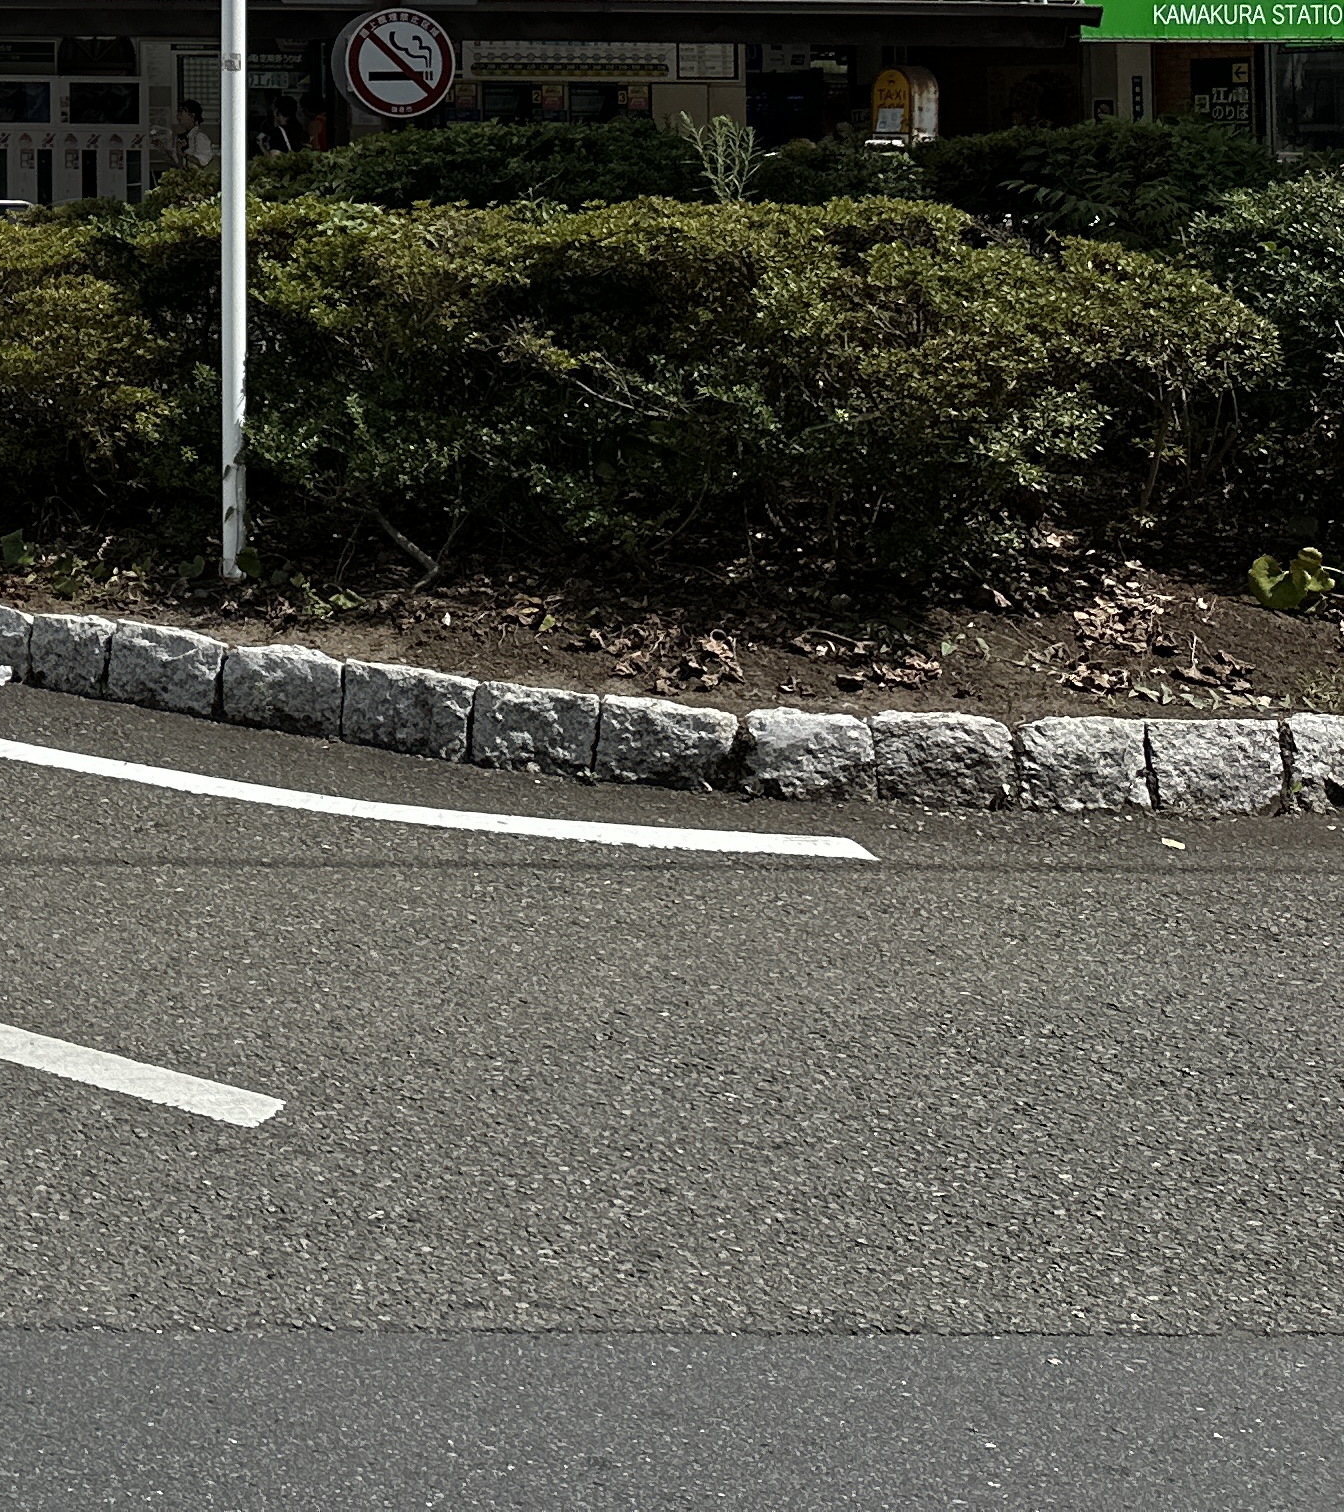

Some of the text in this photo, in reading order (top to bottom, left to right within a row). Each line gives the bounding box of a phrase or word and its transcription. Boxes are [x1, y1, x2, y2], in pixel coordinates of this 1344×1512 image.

[1153, 4, 1266, 25] KAMAKURA
[877, 88, 906, 101] TAXI
[1212, 86, 1250, 103] 江ノ電
[1212, 104, 1249, 120] のりば
